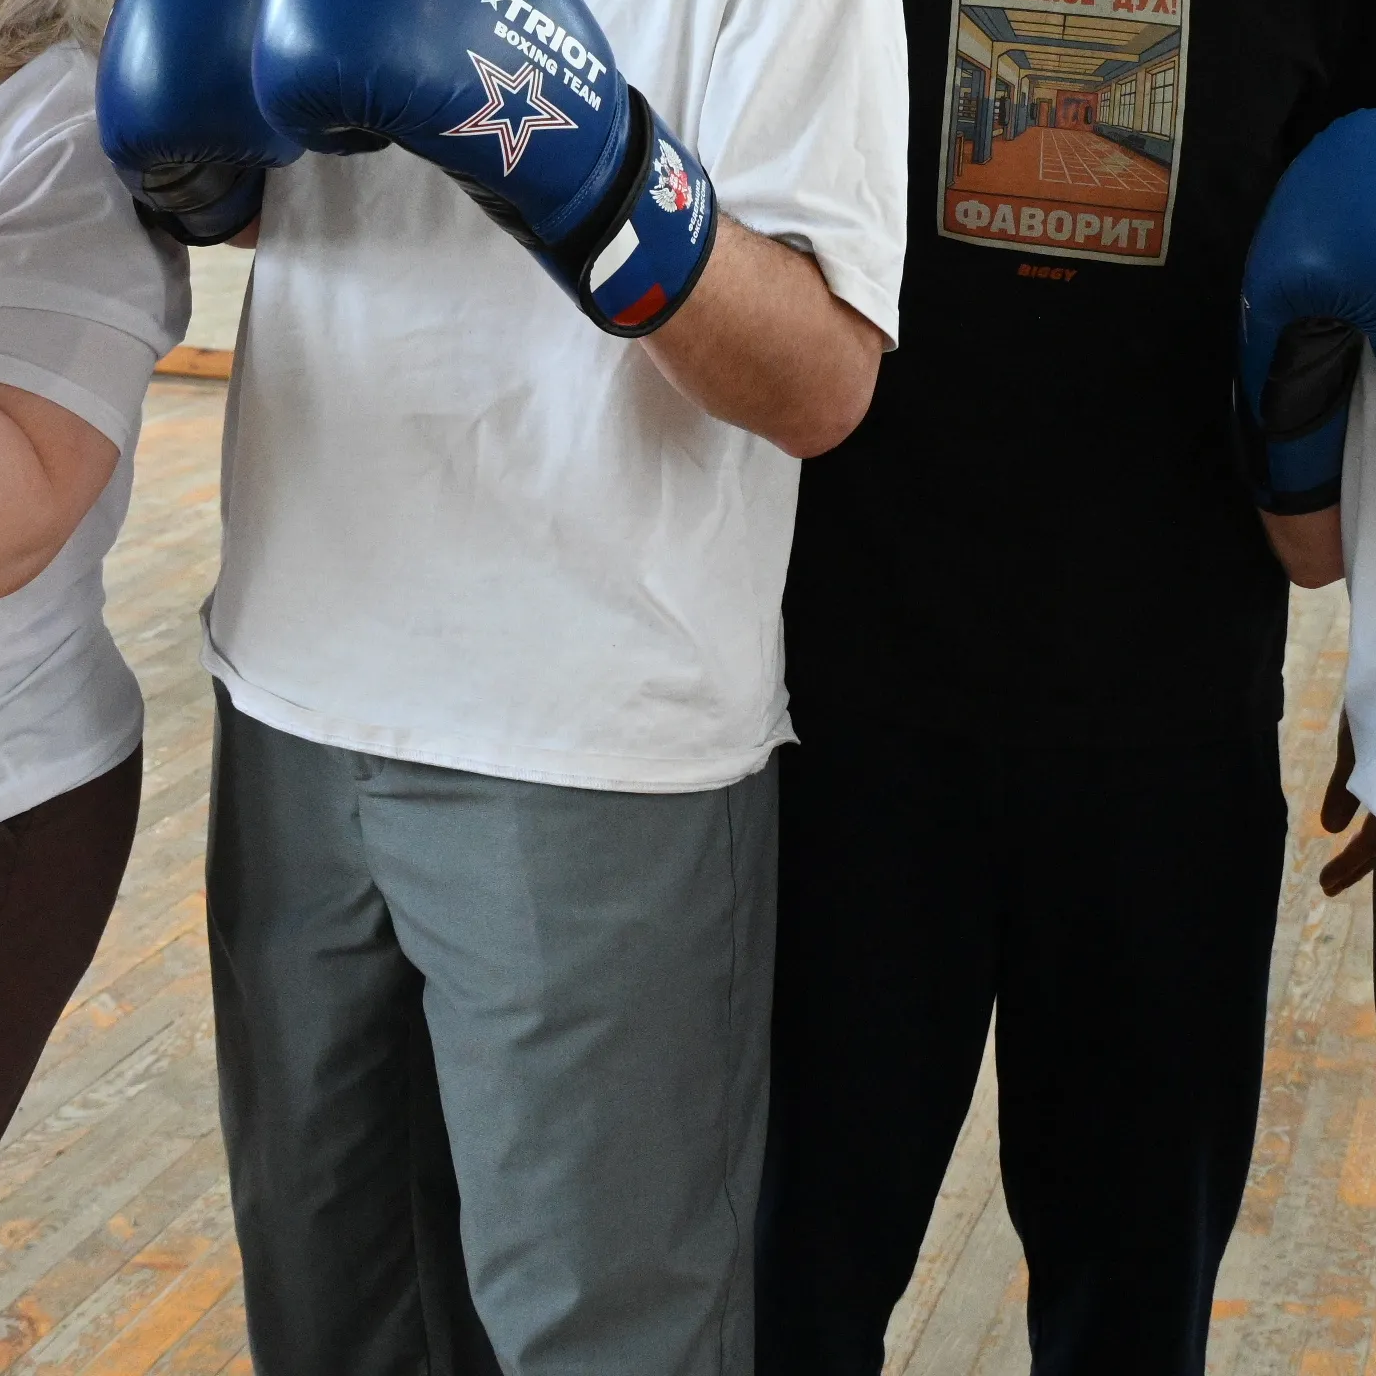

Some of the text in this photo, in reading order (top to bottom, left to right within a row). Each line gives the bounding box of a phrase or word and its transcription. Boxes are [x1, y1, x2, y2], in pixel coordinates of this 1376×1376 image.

[492, 20, 603, 112] BOXING TEAM
[688, 178, 702, 233] ФЕДЕРАЦИЯ
[690, 213, 704, 245] БОКСА
[954, 198, 1155, 251] ФАВОРИТ
